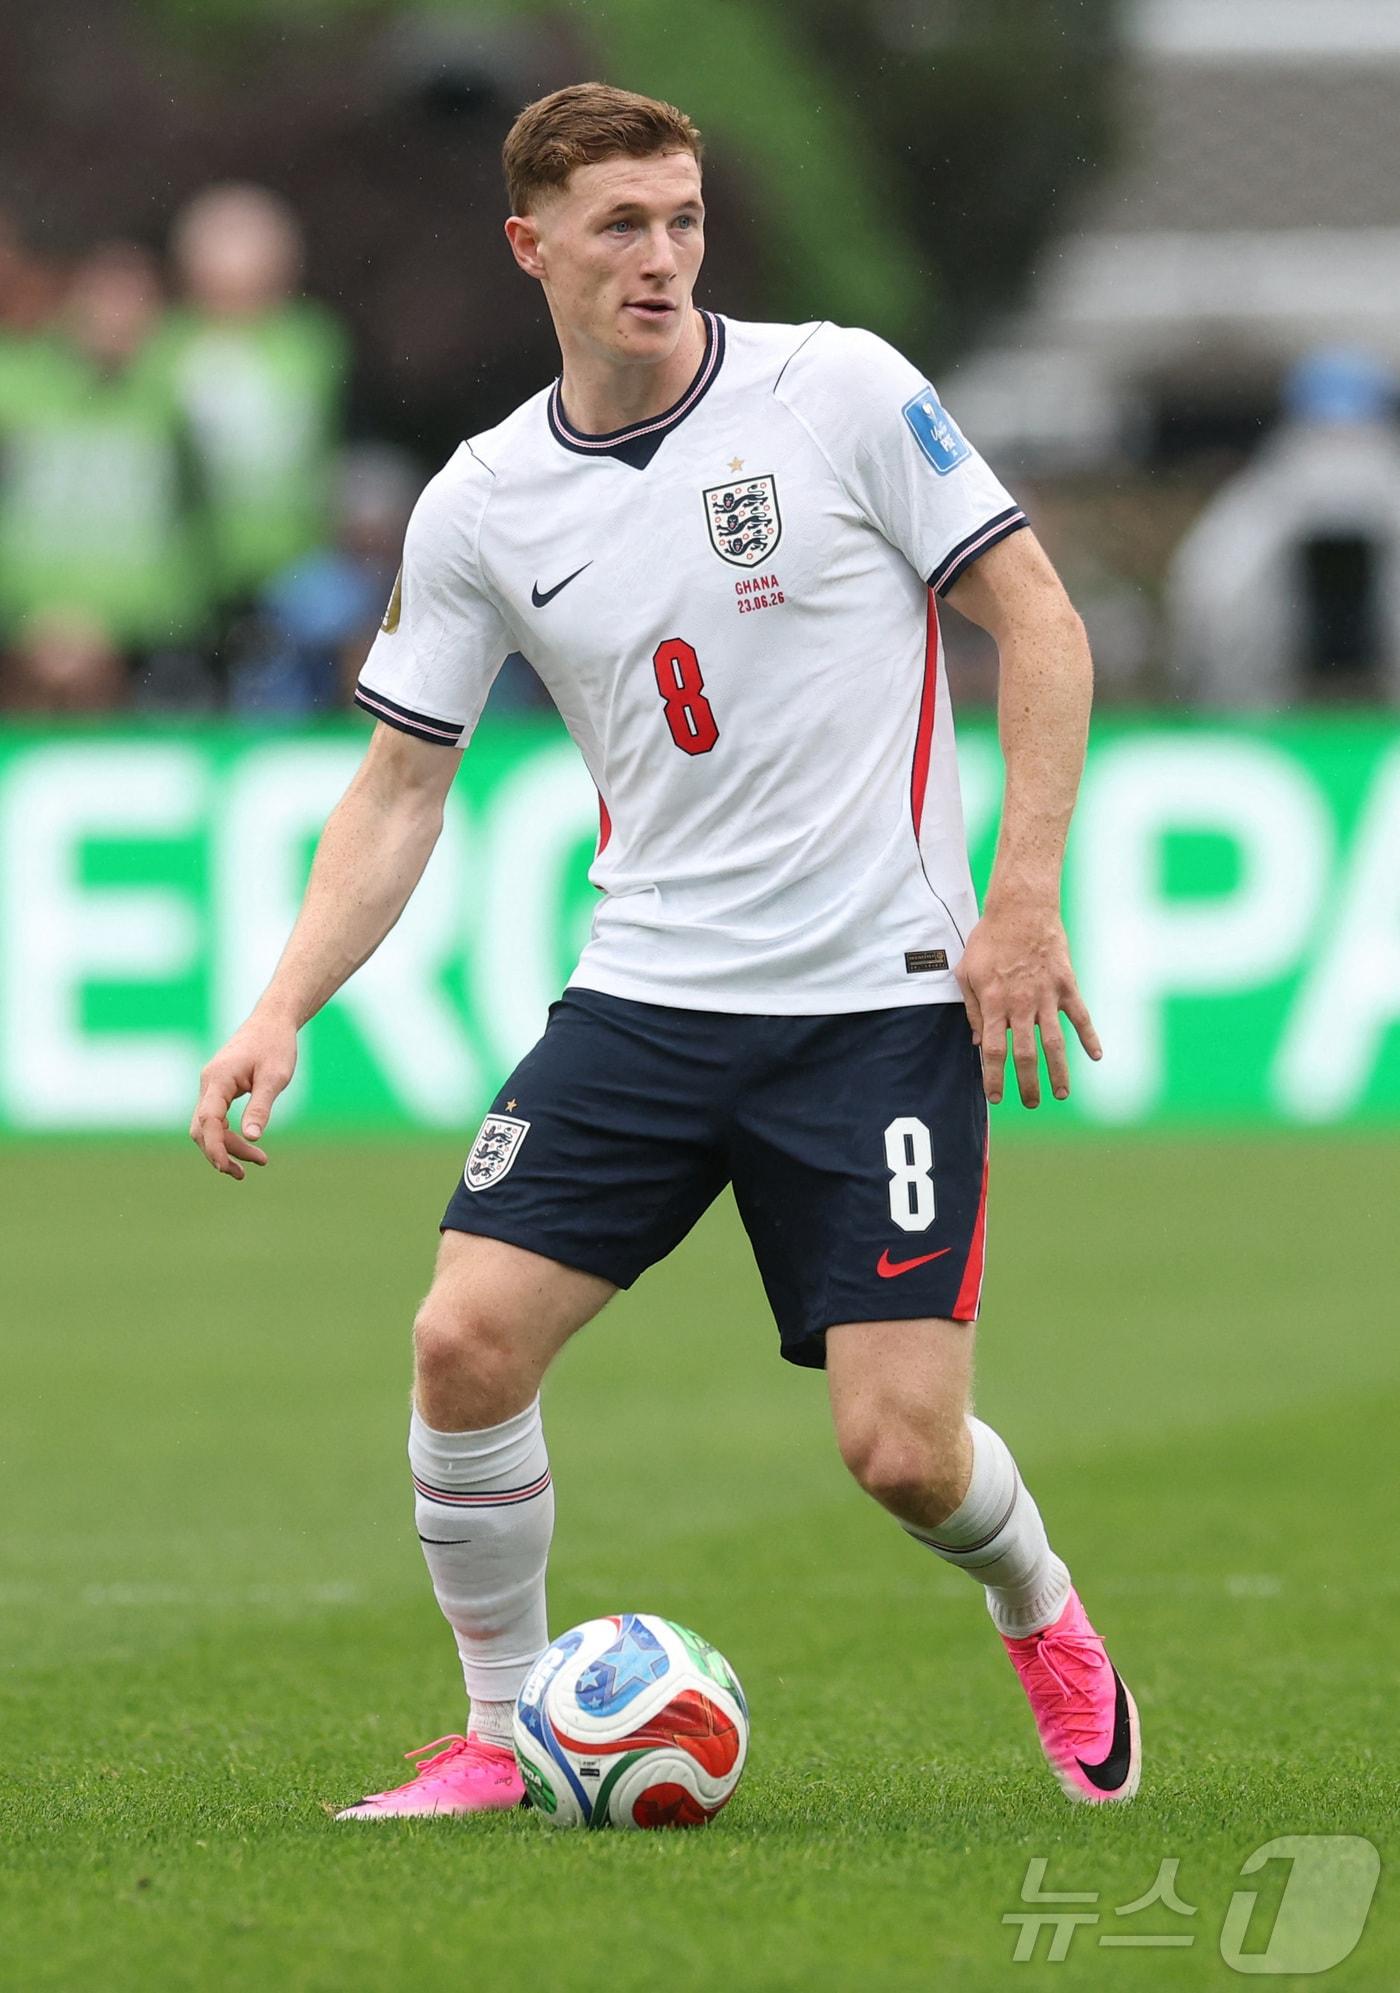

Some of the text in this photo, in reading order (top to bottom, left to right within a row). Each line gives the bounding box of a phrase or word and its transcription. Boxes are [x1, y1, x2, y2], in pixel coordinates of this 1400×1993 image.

[735, 574, 779, 595] GHANA
[737, 592, 785, 614] 23.06.26
[653, 638, 720, 756] 8
[883, 1116, 937, 1233] 8
